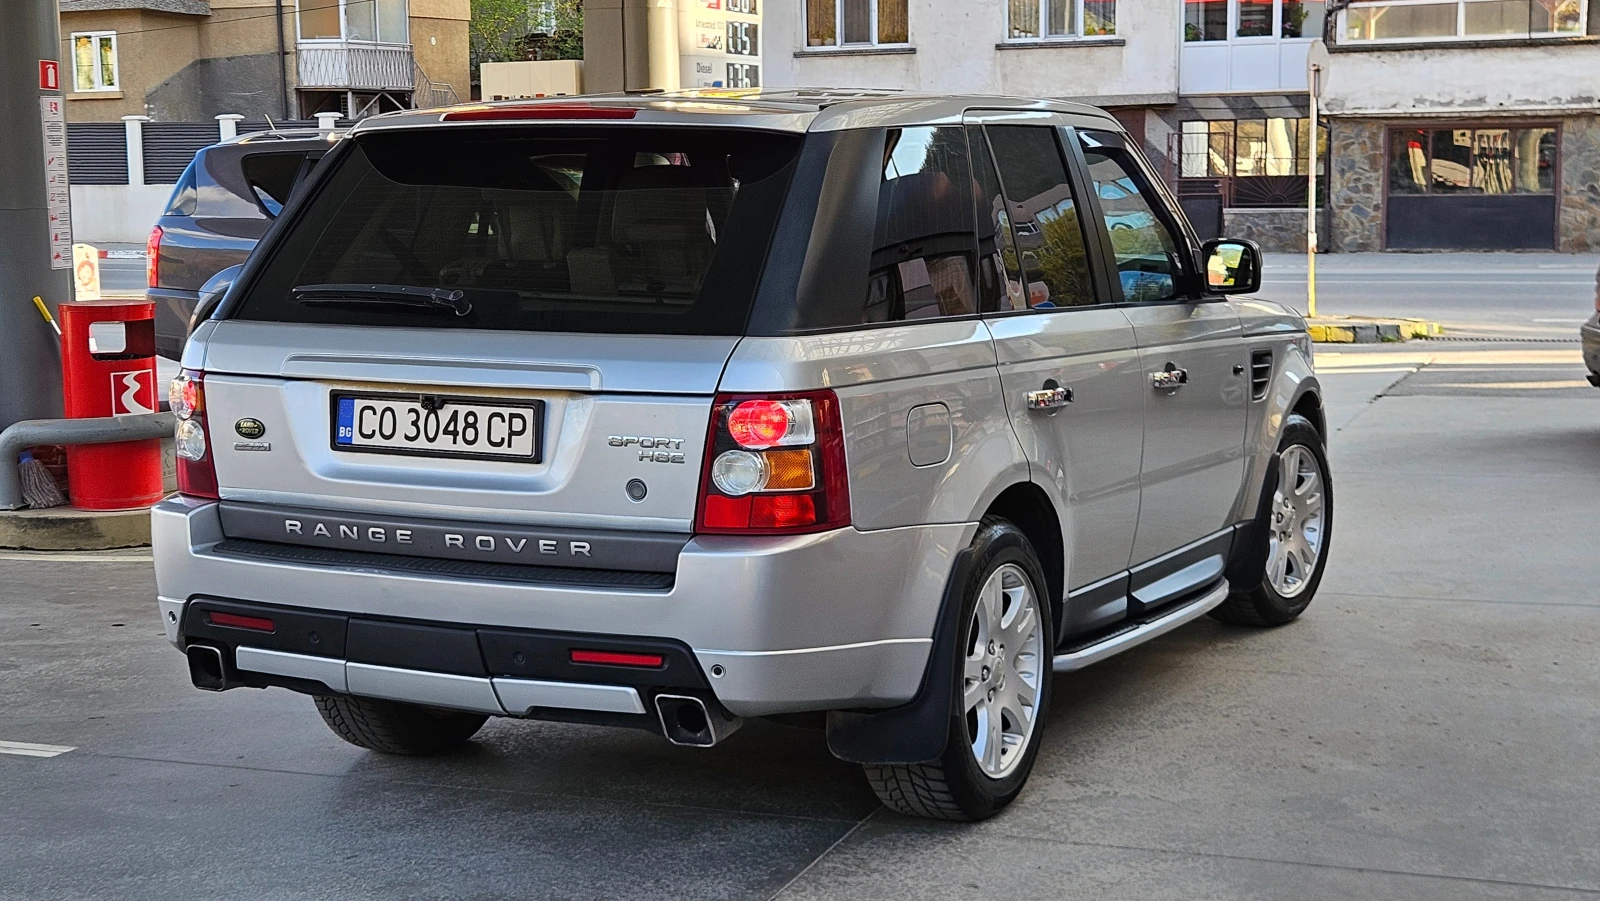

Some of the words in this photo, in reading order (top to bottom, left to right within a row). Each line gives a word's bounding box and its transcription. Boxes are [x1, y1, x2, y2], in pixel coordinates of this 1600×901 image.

[697, 62, 712, 74] Diesel
[339, 427, 352, 438] BG
[358, 405, 397, 440] CO
[403, 408, 479, 446] 3048
[487, 412, 527, 449] CP
[607, 435, 686, 450] SPORT
[638, 450, 686, 464] HSE
[284, 519, 413, 544] RANGE
[445, 533, 593, 557] ROVER
